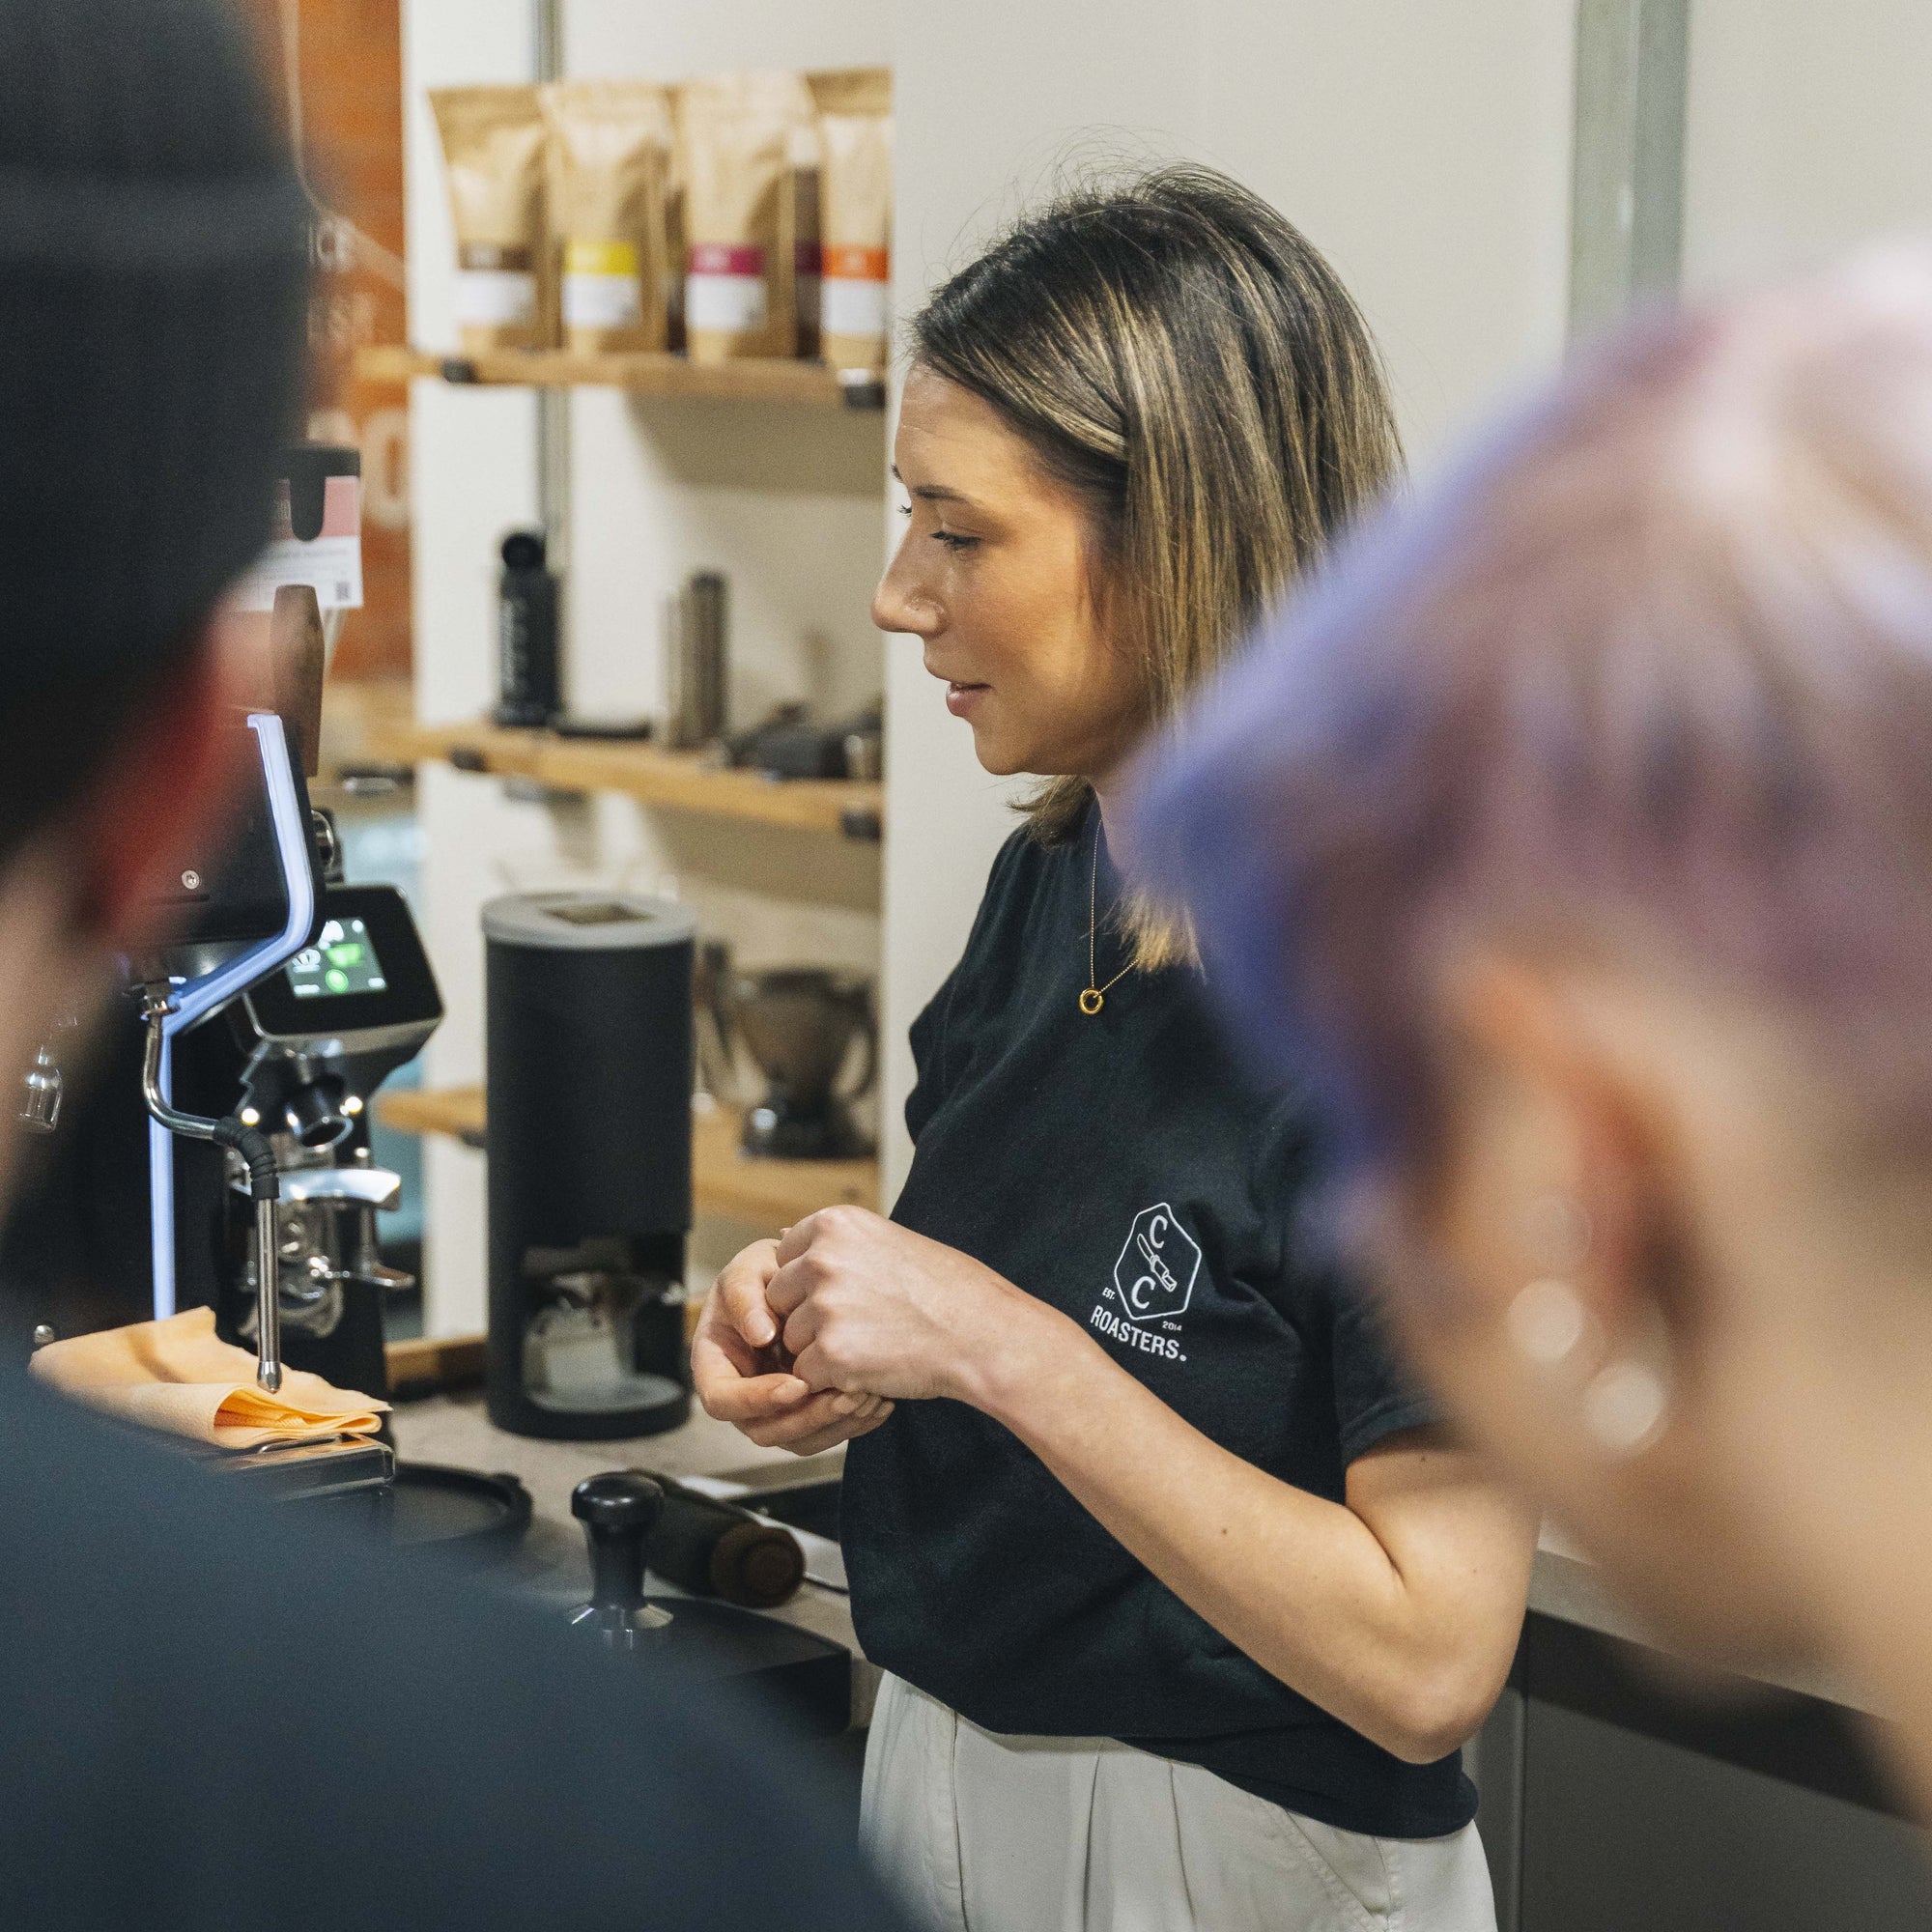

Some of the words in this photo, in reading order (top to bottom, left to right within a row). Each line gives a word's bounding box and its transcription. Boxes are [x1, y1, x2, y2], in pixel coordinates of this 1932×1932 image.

[1150, 1215, 1168, 1248] C
[1102, 1287, 1116, 1299] EST.
[1131, 1276, 1155, 1309] C
[1090, 1305, 1187, 1362] ROASTERS.
[1162, 1321, 1181, 1331] 2014
